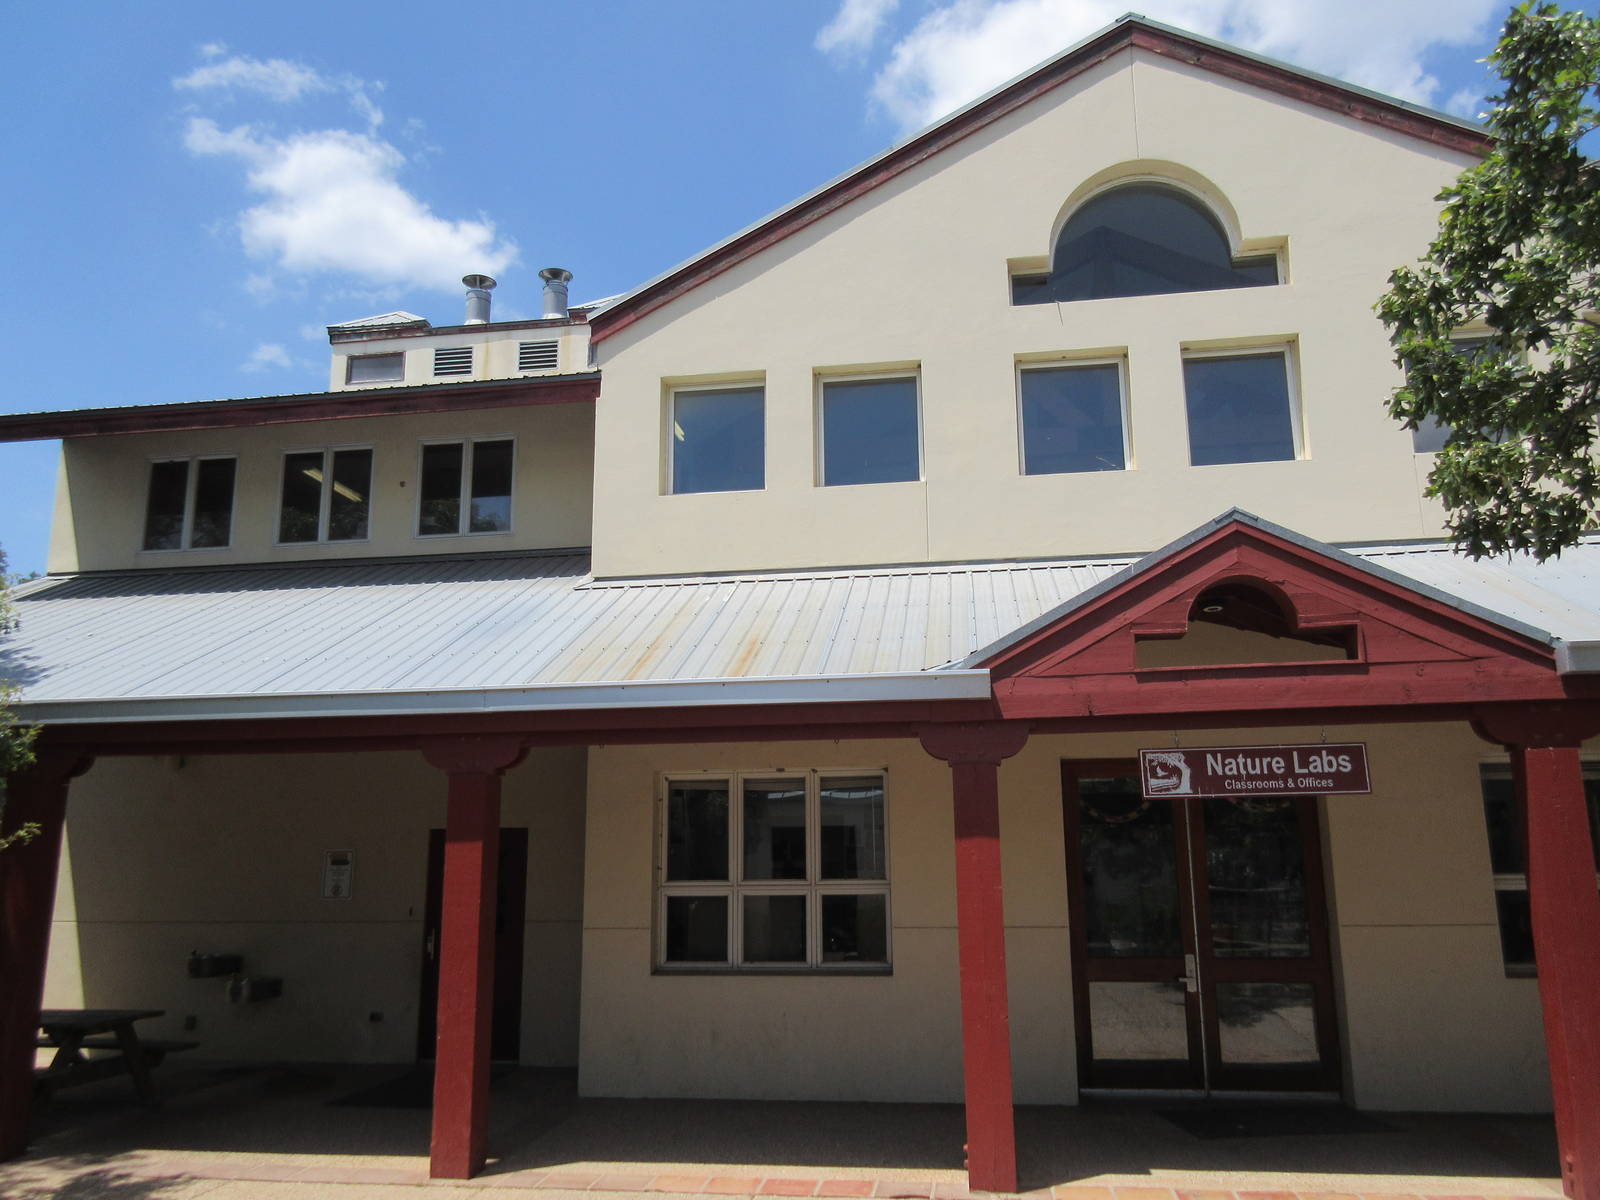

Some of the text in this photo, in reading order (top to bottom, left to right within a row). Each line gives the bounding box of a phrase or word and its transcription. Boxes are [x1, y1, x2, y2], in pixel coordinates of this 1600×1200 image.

[1205, 749, 1353, 776] Nature Labs
[1224, 776, 1334, 789] Classrooms & Offices
